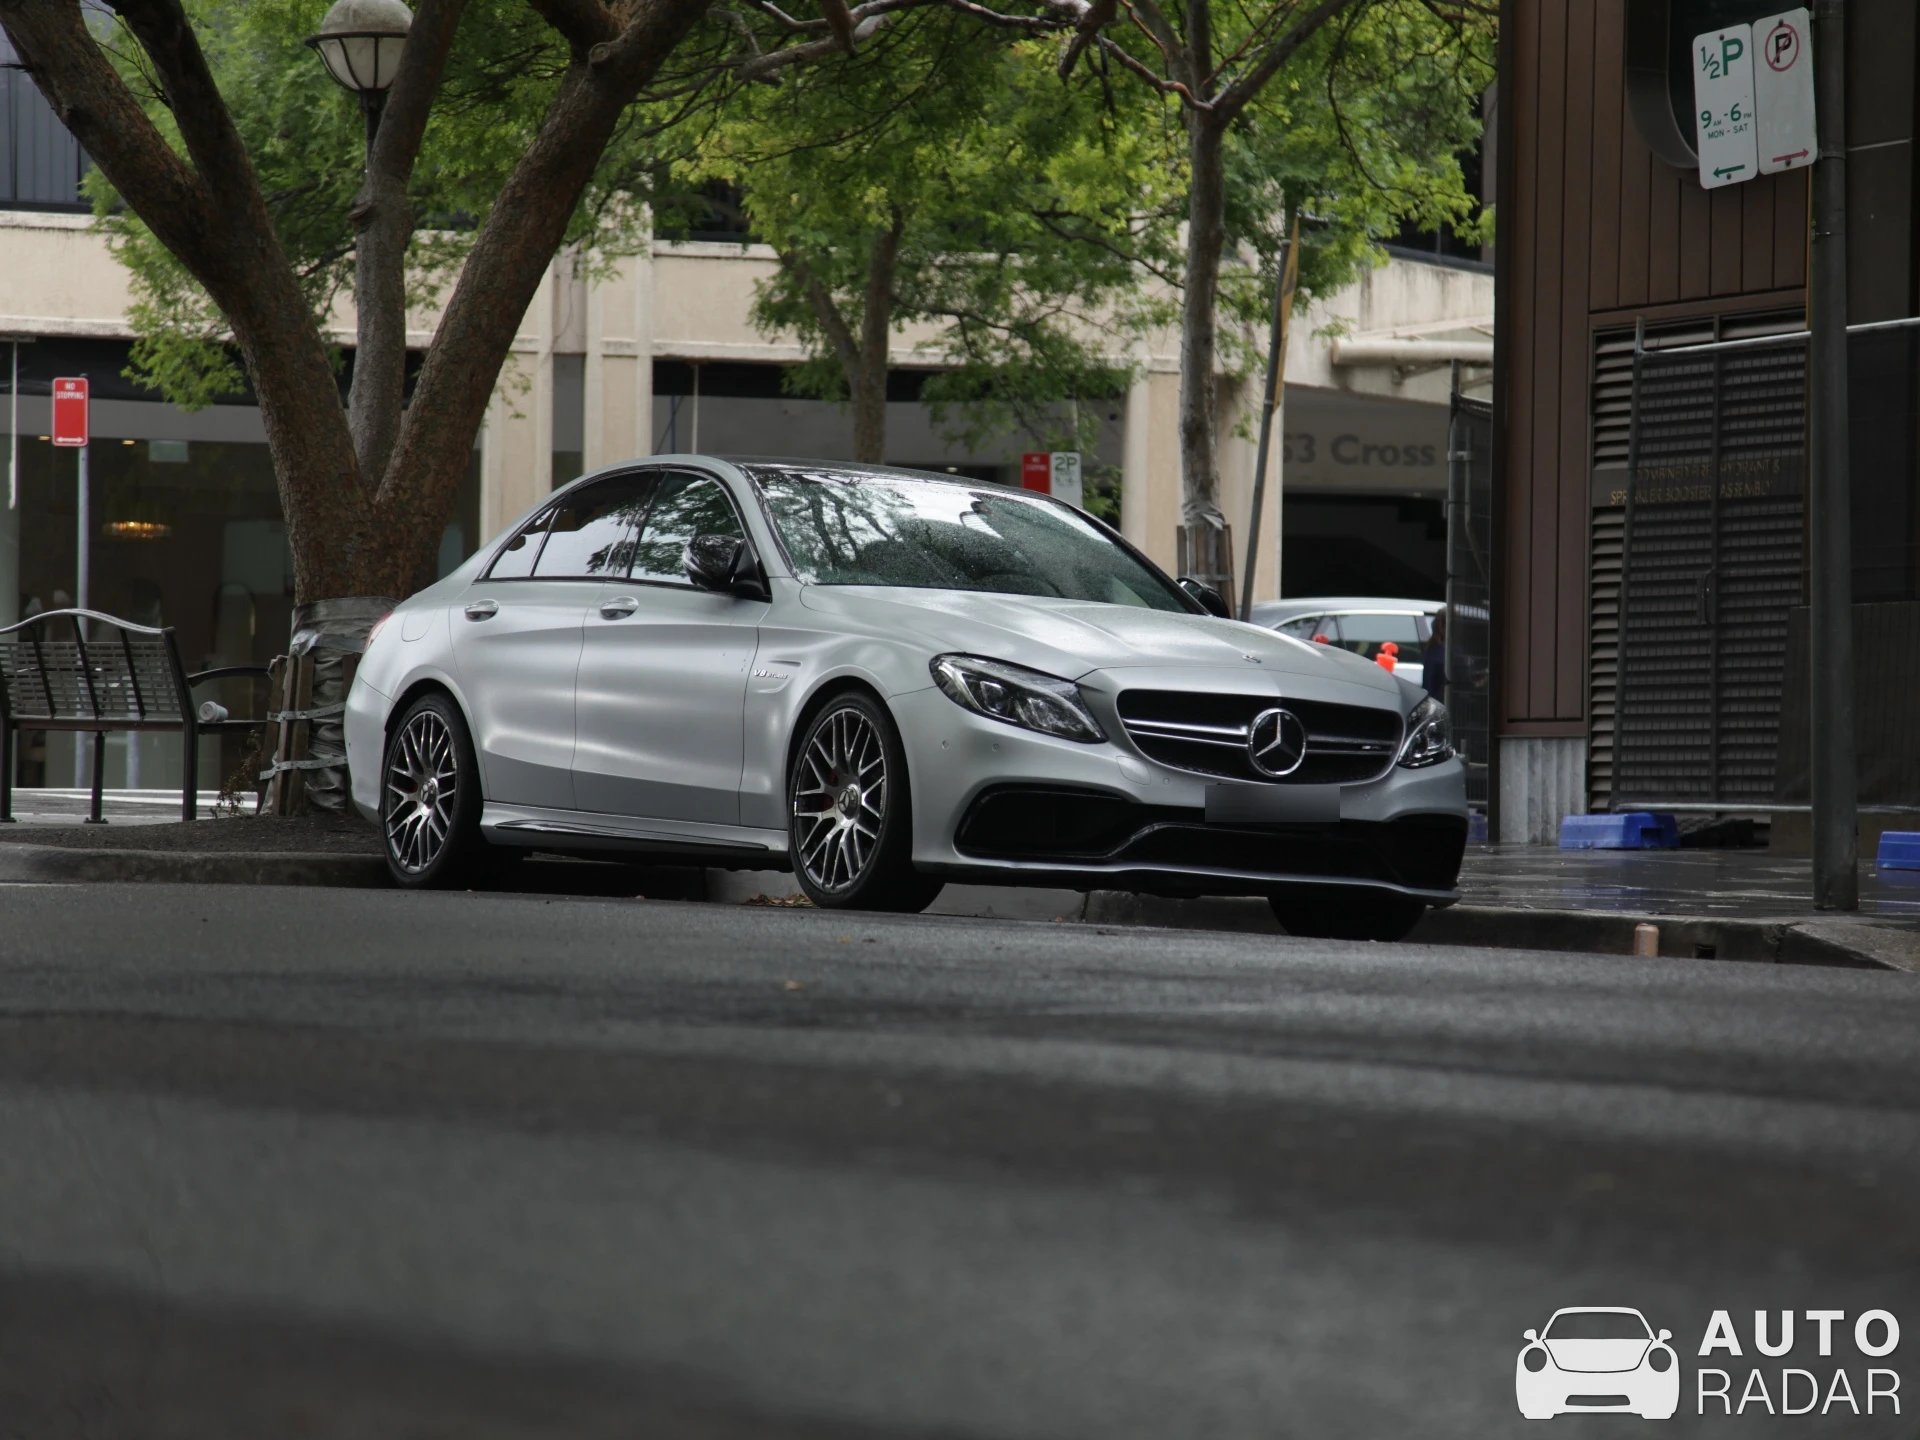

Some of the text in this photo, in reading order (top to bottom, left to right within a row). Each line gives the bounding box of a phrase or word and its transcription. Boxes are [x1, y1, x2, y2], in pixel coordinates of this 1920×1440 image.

[1708, 129, 1724, 139] MON
[1733, 123, 1748, 134] SAT
[65, 382, 76, 390] NO
[56, 391, 85, 400] STOPPING
[1330, 432, 1436, 467] Cross
[1055, 456, 1078, 471] 2P
[754, 669, 767, 677] V8
